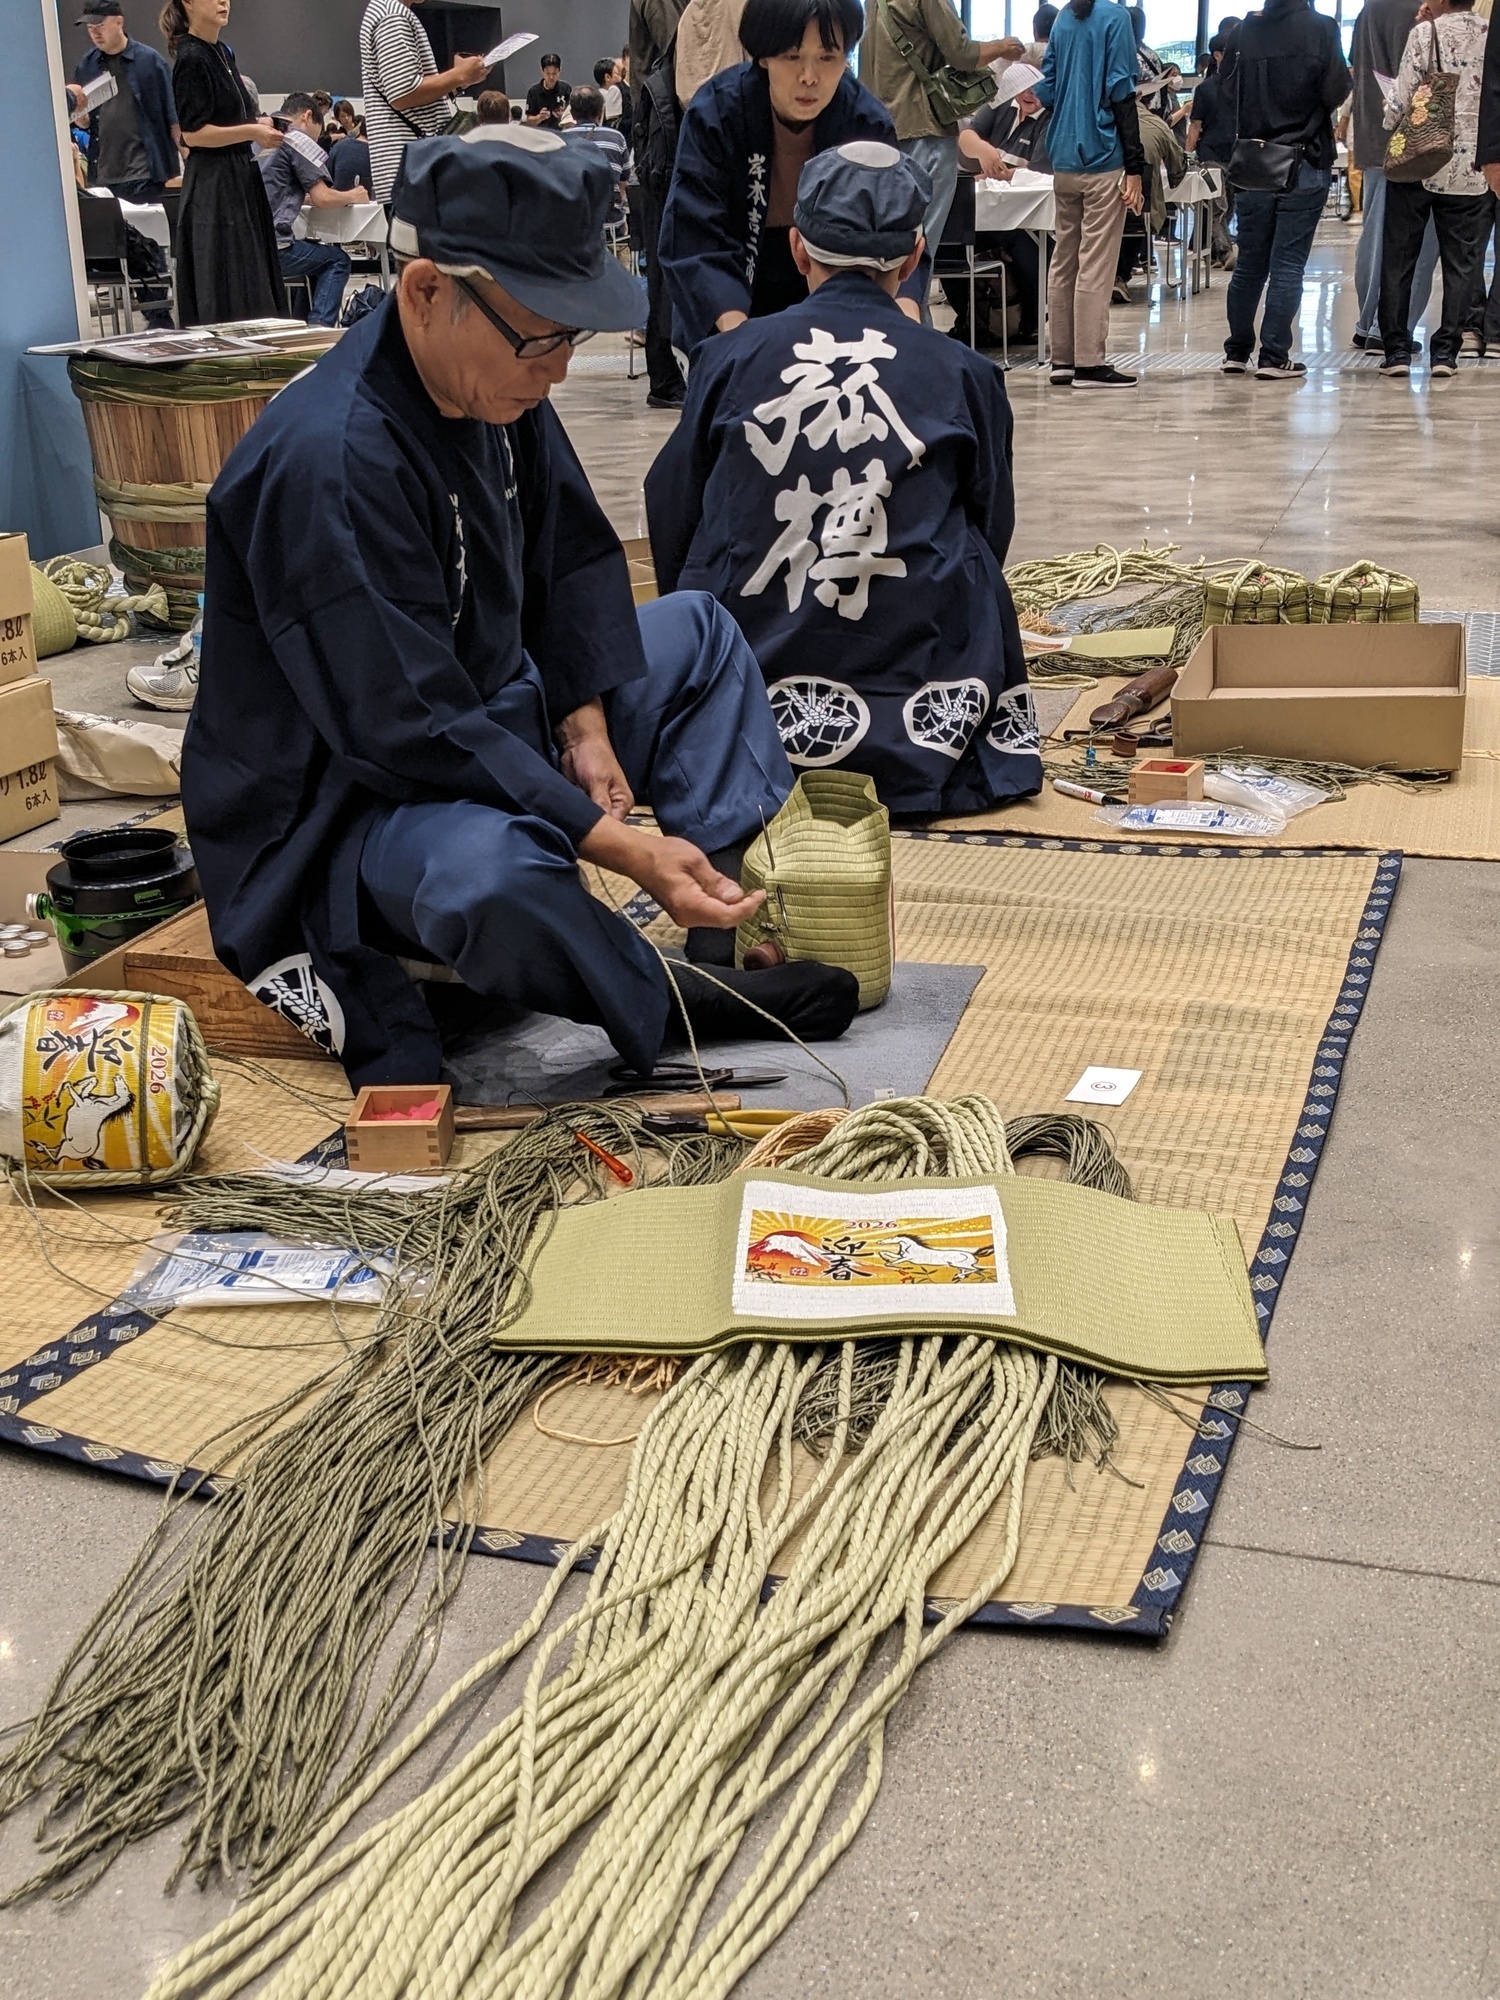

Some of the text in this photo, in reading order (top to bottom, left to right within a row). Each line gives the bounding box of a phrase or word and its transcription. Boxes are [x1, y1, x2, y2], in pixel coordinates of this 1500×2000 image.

[1, 646, 28, 666] 6本入
[25, 789, 52, 811] 6本入
[36, 1028, 135, 1073] 迎春
[149, 1045, 169, 1095] 2026
[845, 1220, 899, 1230] 2026
[820, 1236, 875, 1281] 迎春
